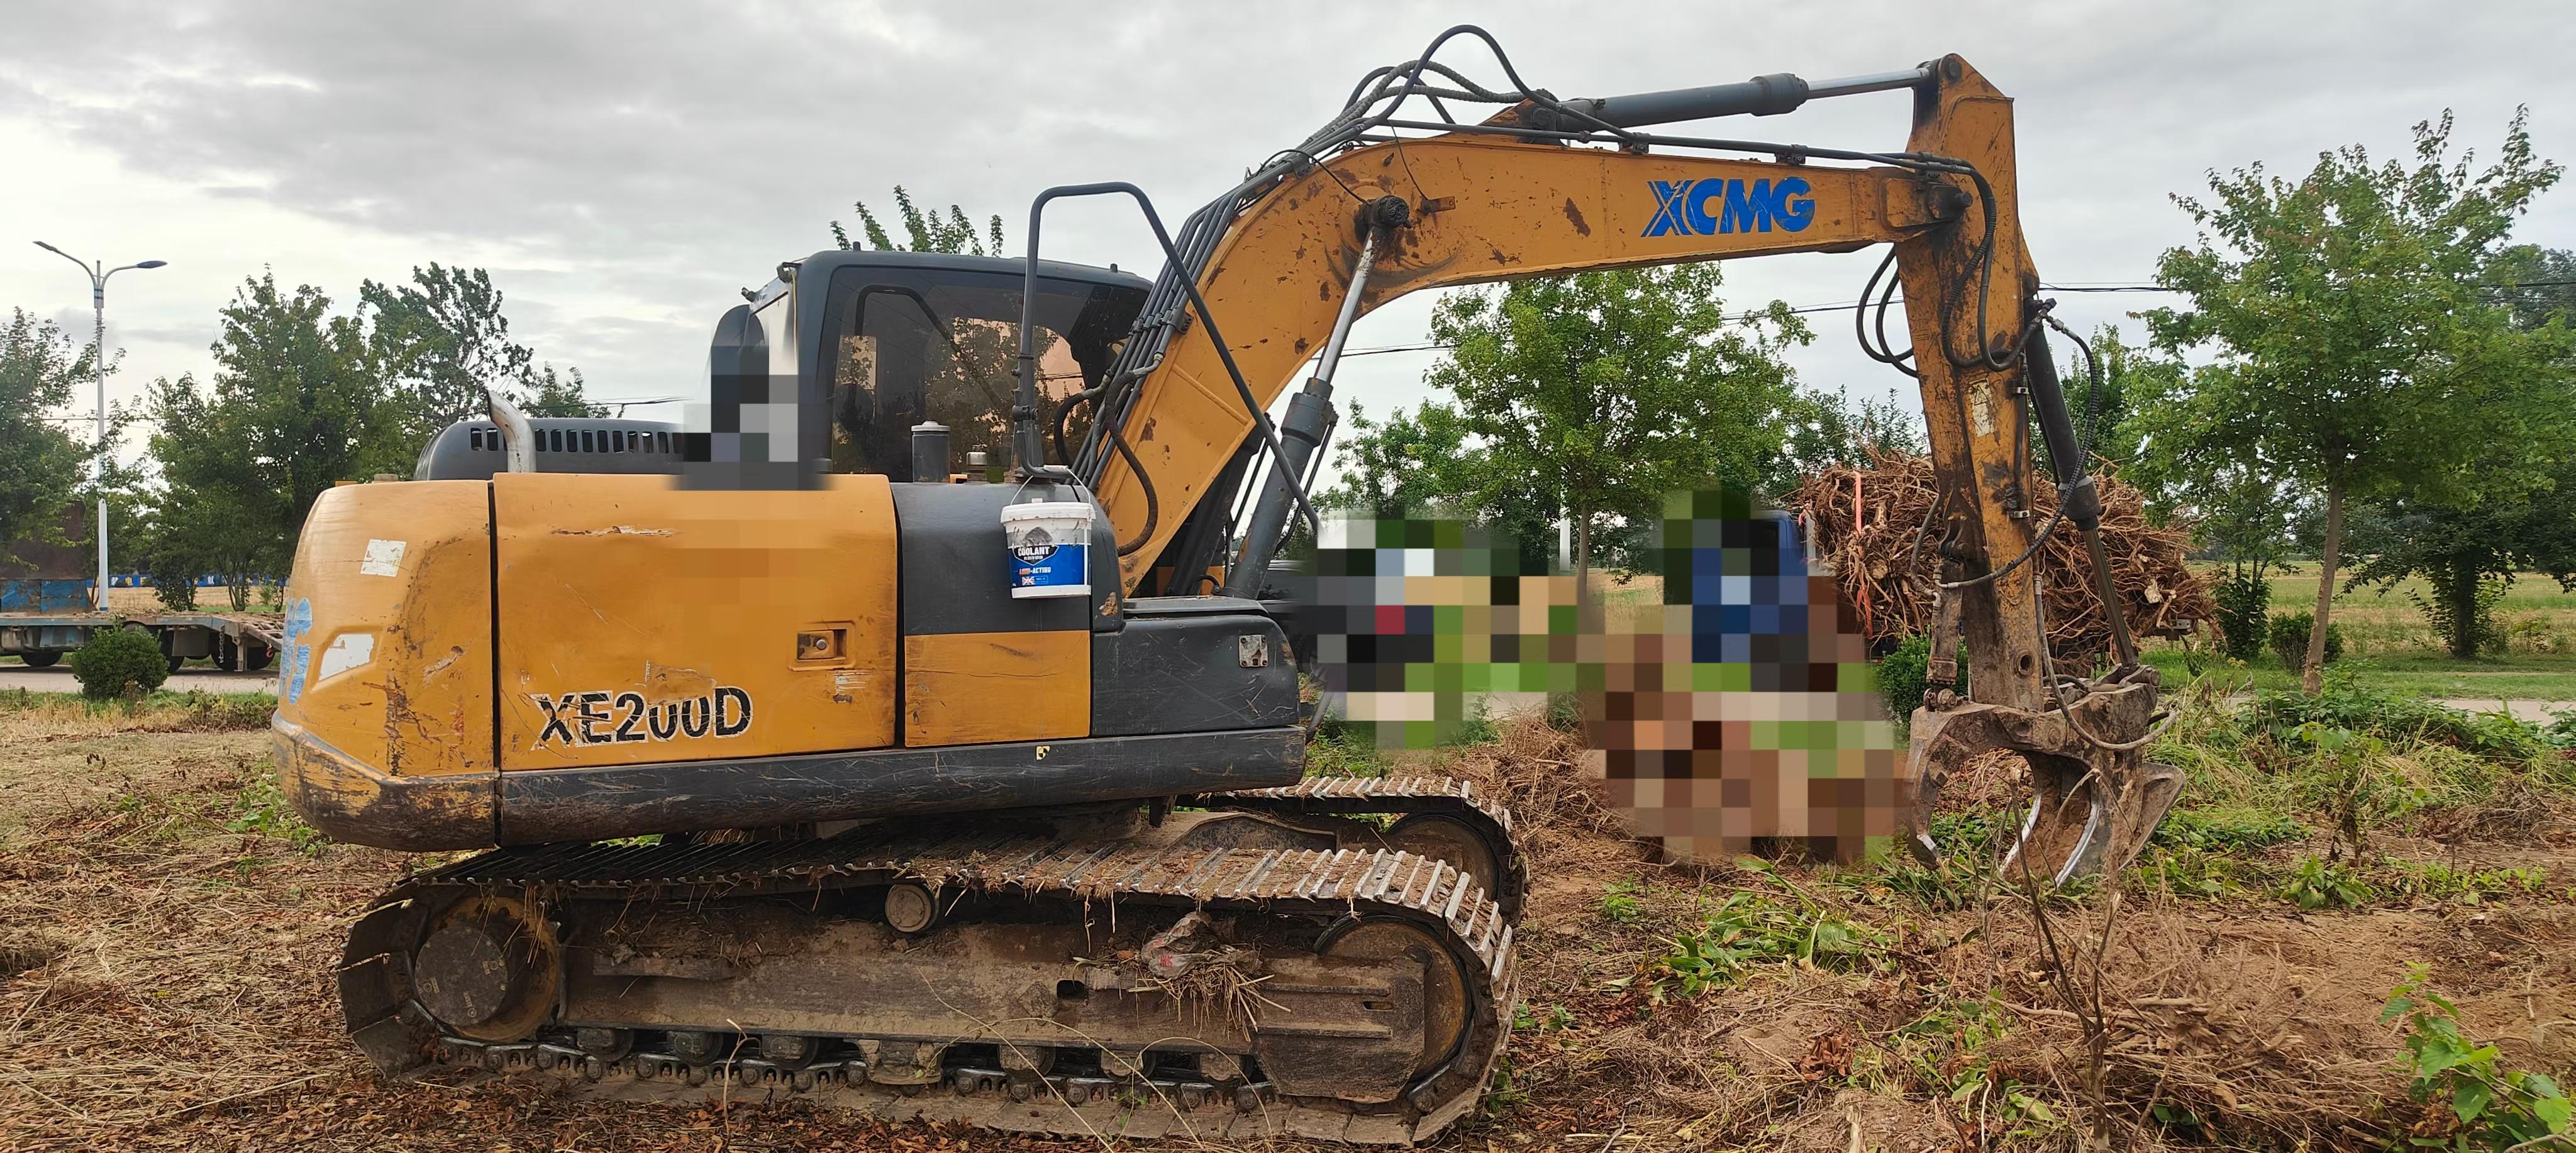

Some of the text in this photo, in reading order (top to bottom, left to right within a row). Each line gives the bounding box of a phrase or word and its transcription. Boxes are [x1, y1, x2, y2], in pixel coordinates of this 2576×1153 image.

[1640, 177, 1816, 238] XCMG
[1018, 546, 1050, 556] COOLANT
[531, 686, 753, 750] XE200D
